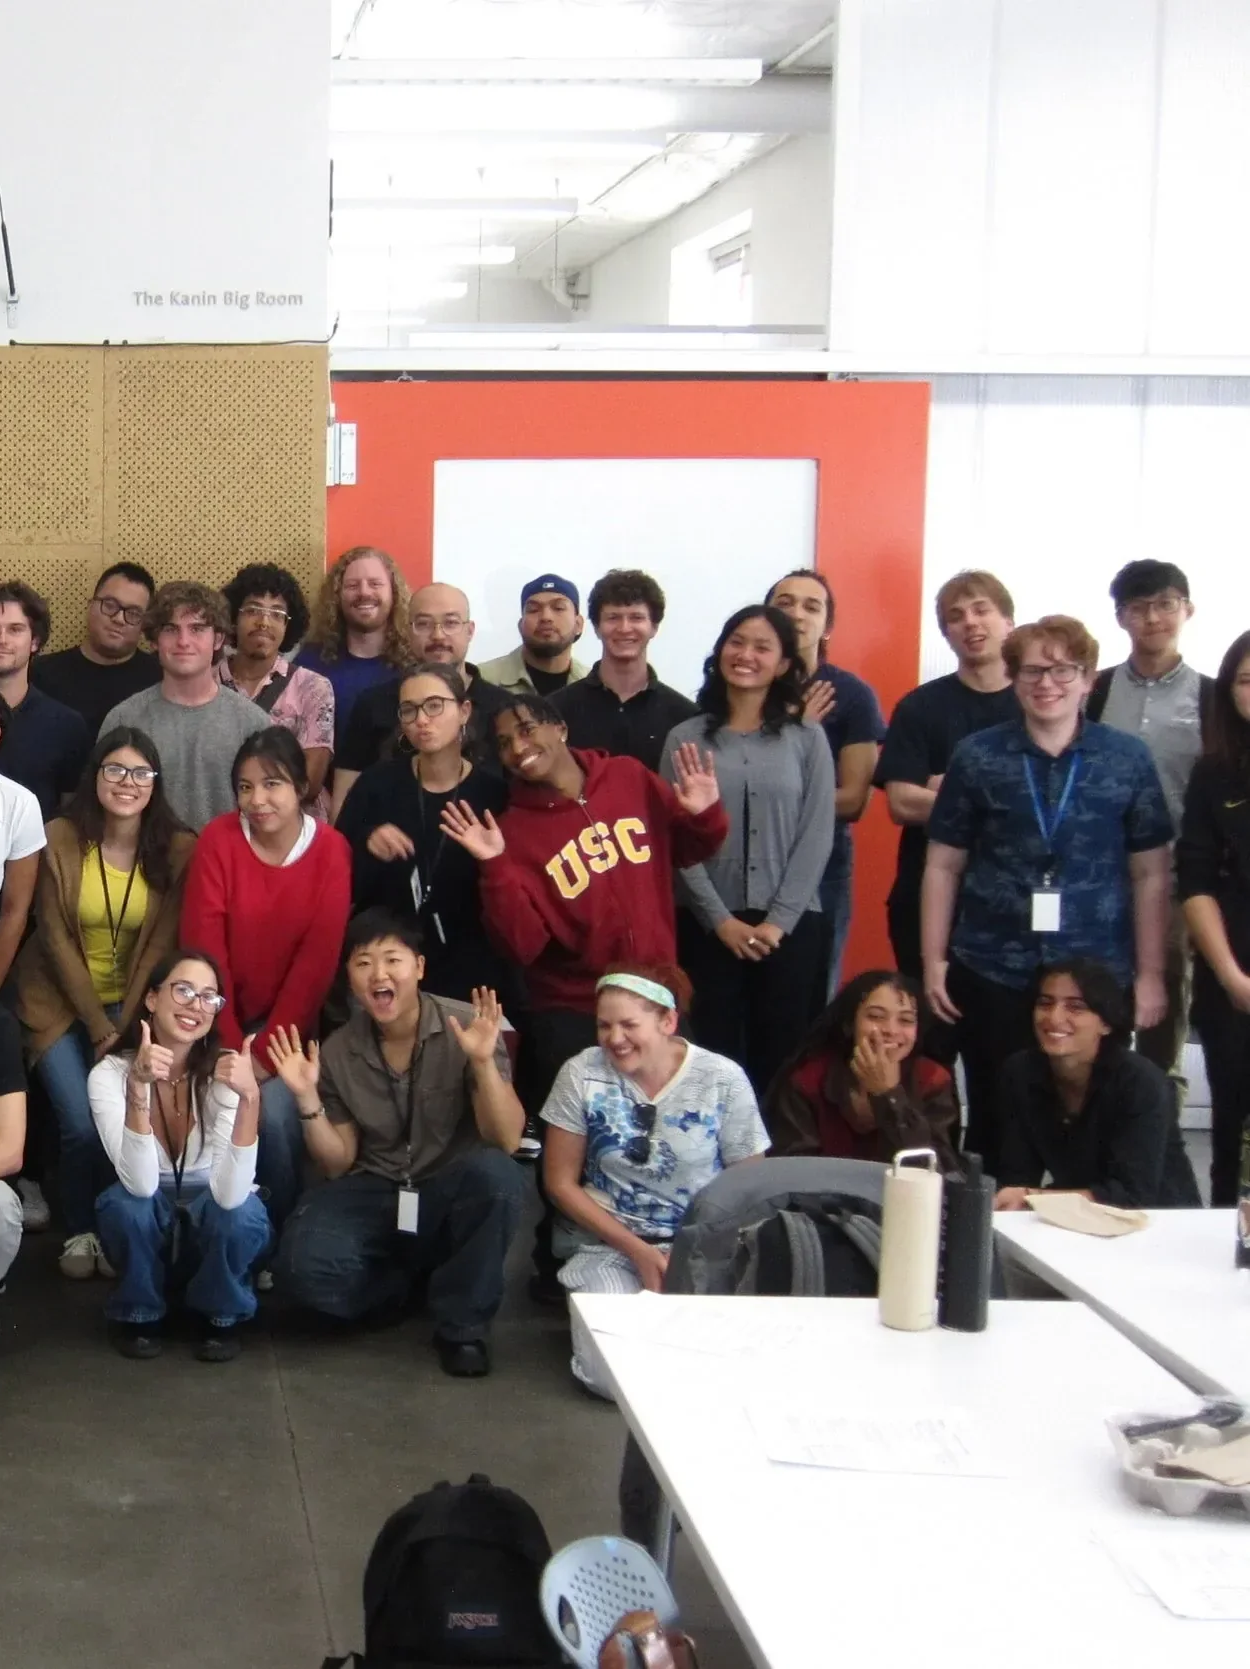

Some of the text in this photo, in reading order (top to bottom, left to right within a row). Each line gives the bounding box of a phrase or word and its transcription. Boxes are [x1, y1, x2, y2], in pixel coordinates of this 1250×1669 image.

[133, 291, 304, 310] The Kanin Big Room
[545, 817, 651, 899] USC
